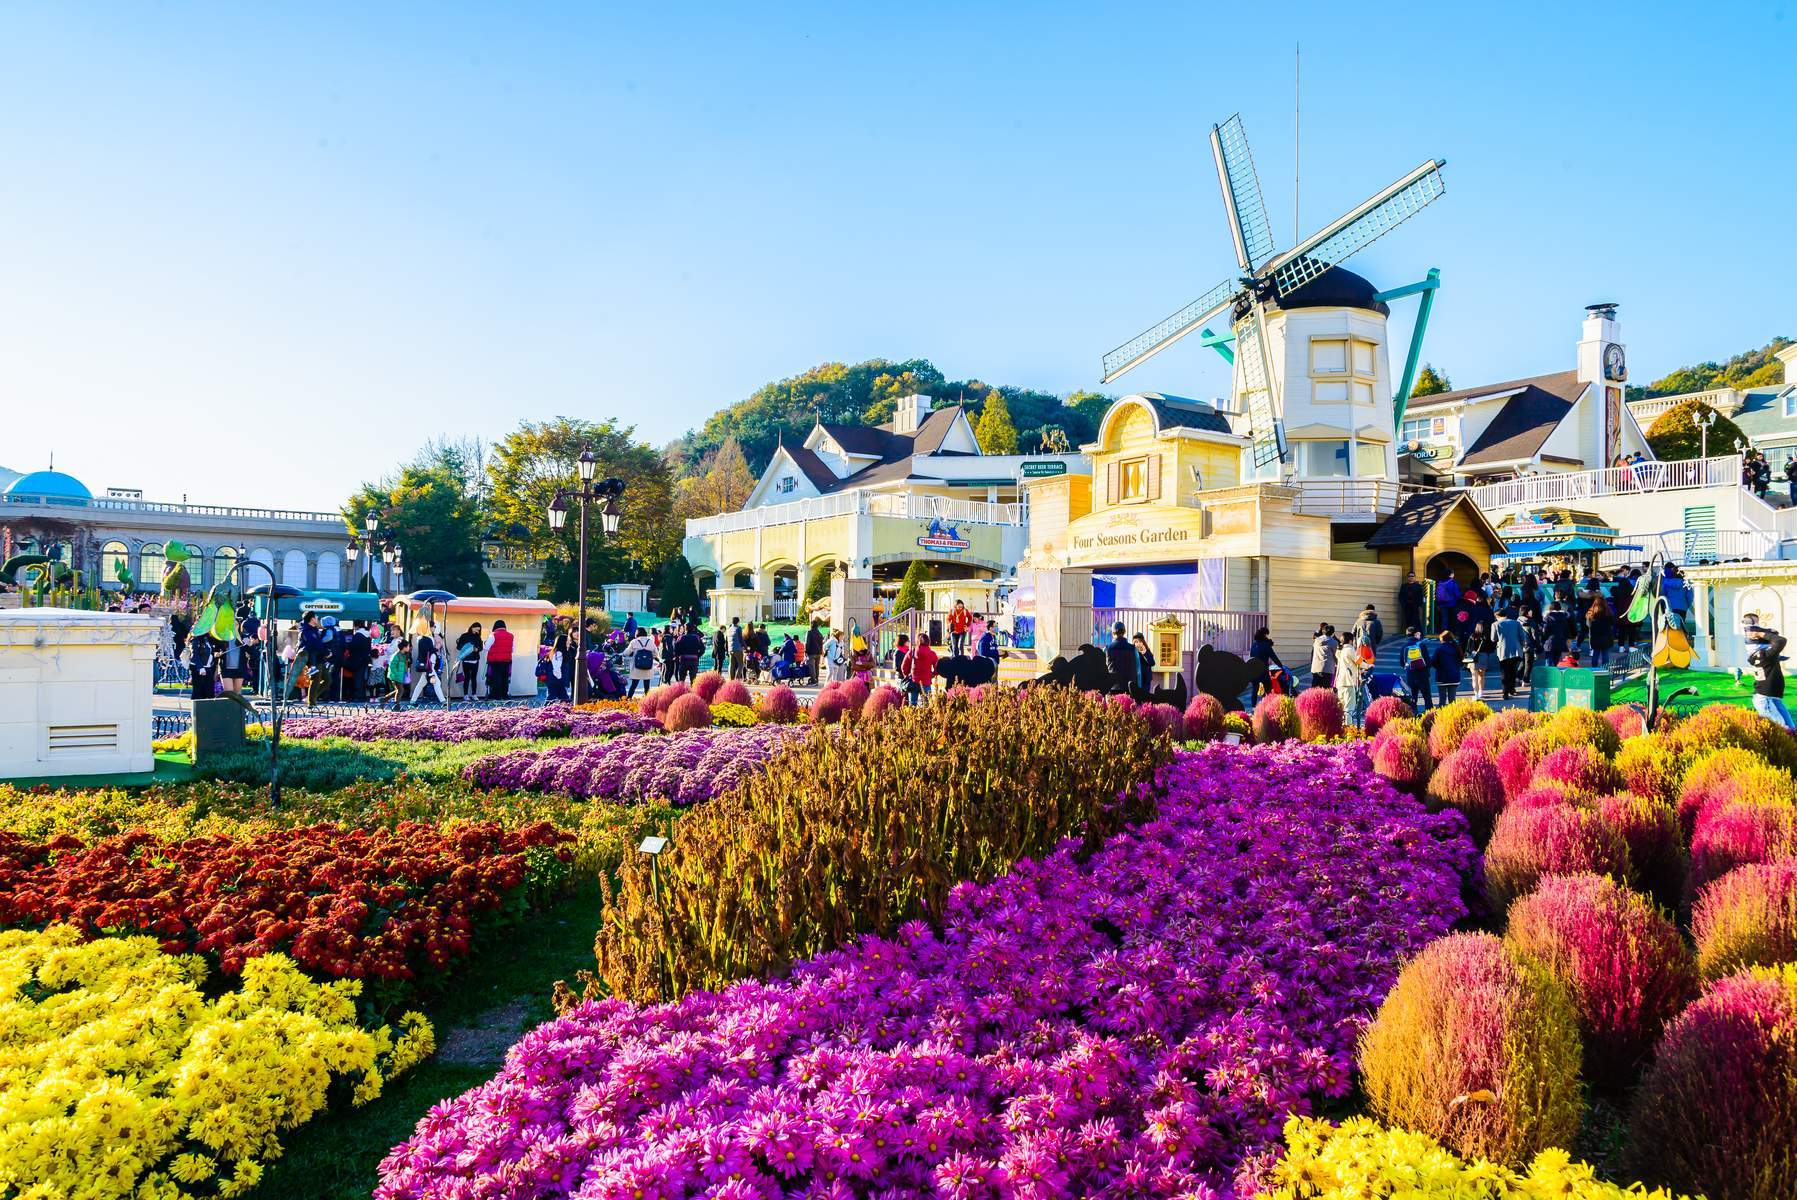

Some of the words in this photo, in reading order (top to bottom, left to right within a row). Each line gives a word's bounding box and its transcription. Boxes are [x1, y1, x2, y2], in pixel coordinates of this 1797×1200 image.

[1073, 536, 1094, 549] Four
[1096, 533, 1137, 547] Seasons
[1140, 528, 1188, 544] Garden
